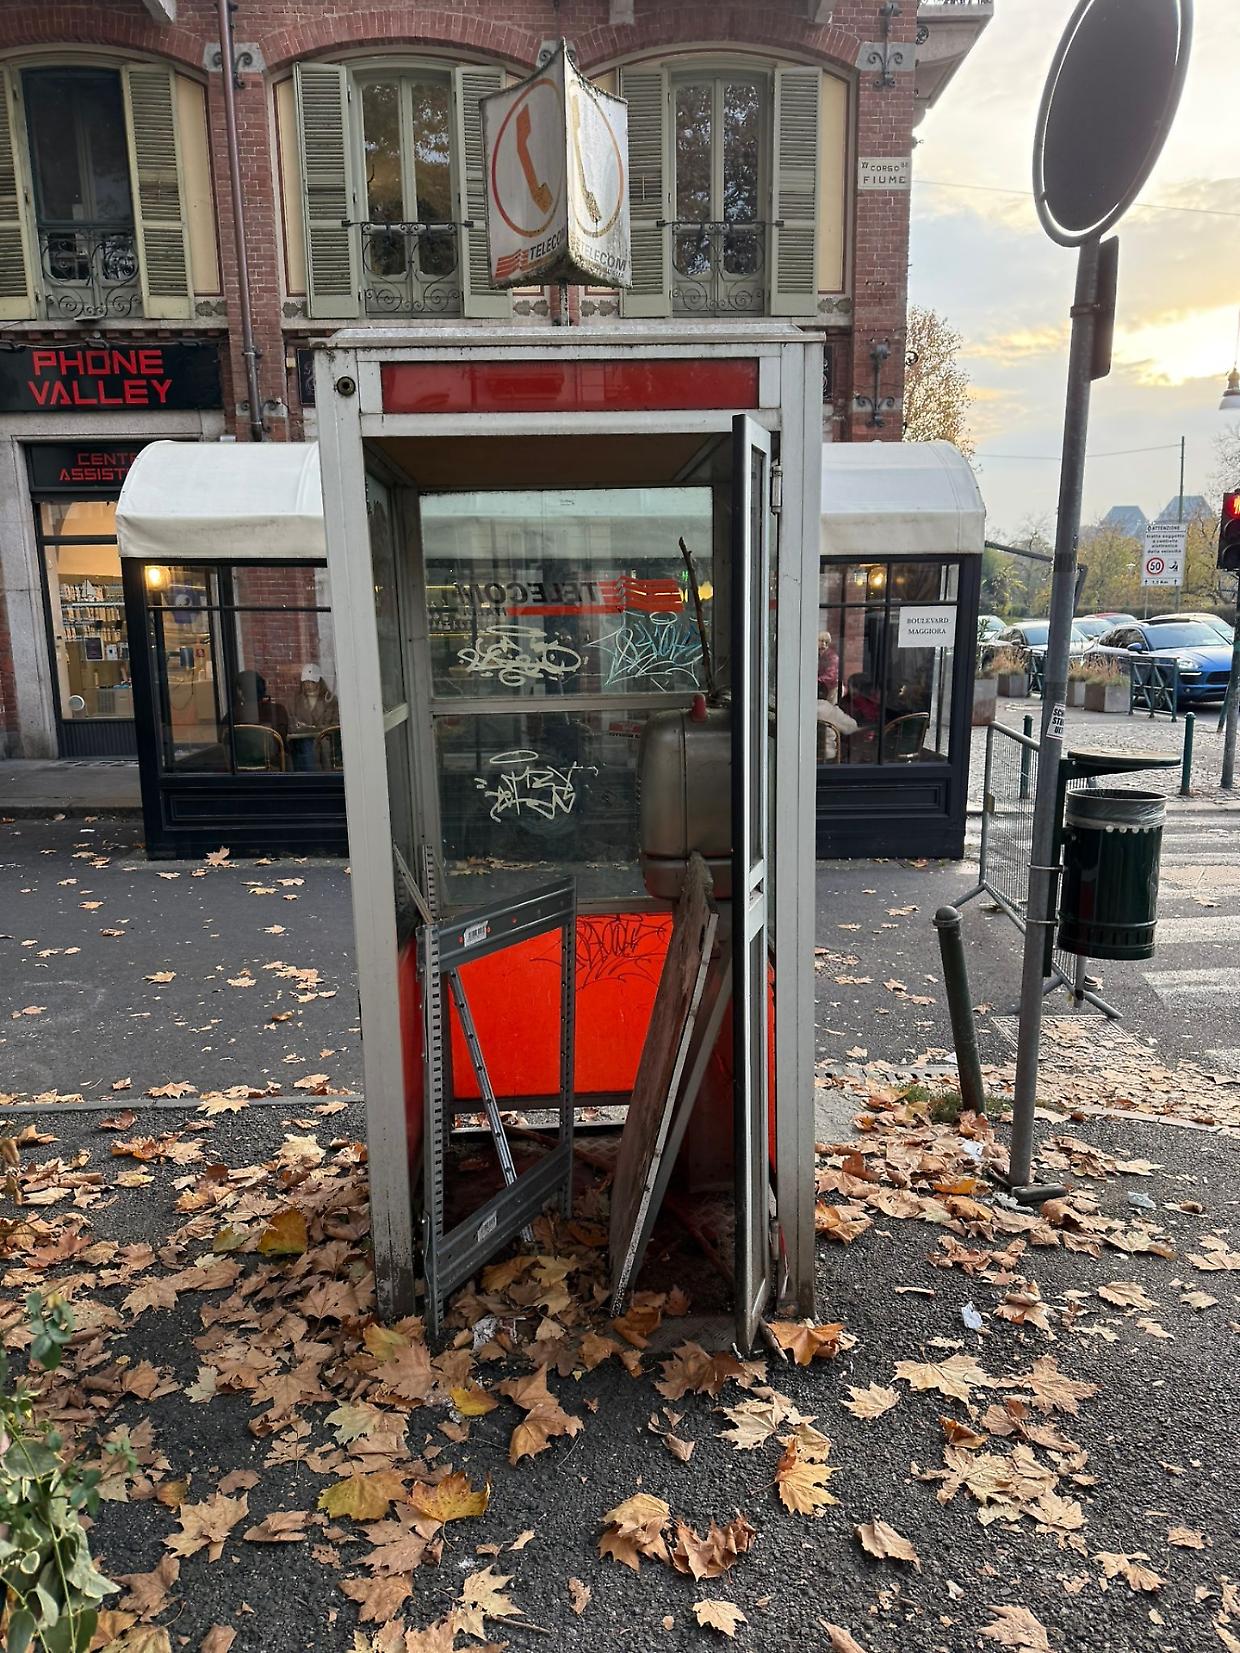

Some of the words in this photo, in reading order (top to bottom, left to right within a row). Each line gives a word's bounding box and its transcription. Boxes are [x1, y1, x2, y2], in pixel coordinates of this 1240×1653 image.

[863, 176, 906, 184] FIUME
[32, 349, 164, 376] PHONE
[28, 379, 173, 406] VALLEY
[60, 467, 129, 481] ASSIST
[1150, 562, 1161, 571] 50
